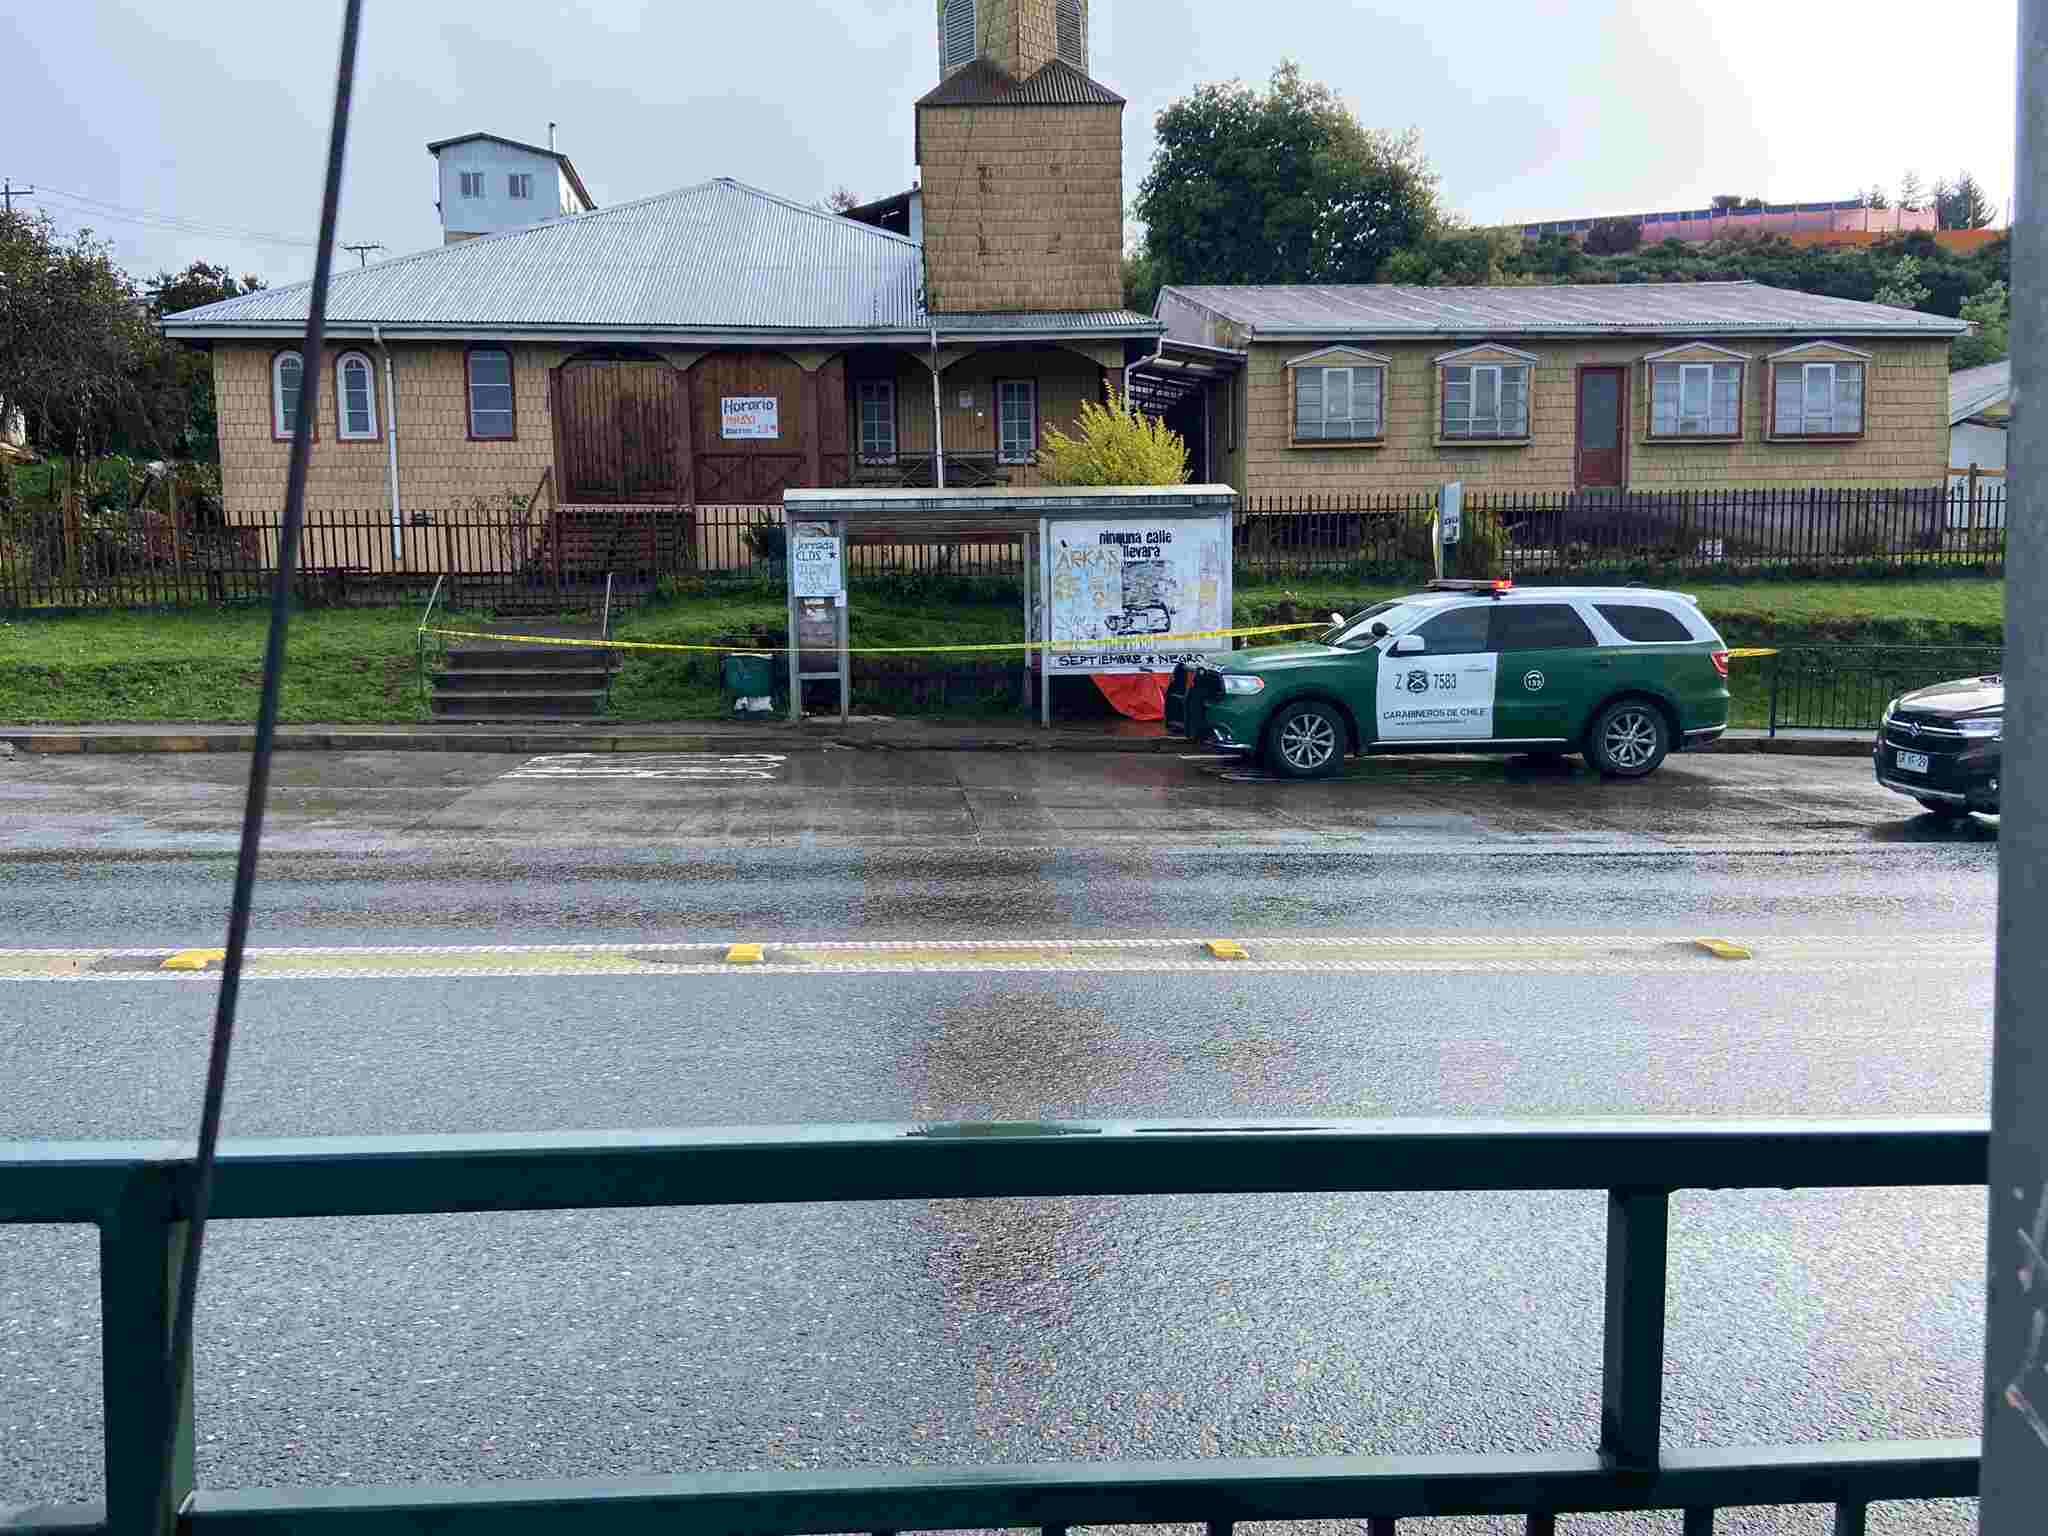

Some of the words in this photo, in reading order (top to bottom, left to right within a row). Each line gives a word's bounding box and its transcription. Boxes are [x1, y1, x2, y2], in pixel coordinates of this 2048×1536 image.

[723, 399, 774, 415] Horario
[1099, 529, 1142, 546] ninguna
[1146, 529, 1172, 544] calle
[1058, 654, 1143, 667] SEPTIEMBRE
[1394, 673, 1402, 690] Z
[1383, 709, 1445, 720] CARABINEROS
[1446, 708, 1458, 718] DE
[1460, 706, 1488, 717] CHILE
